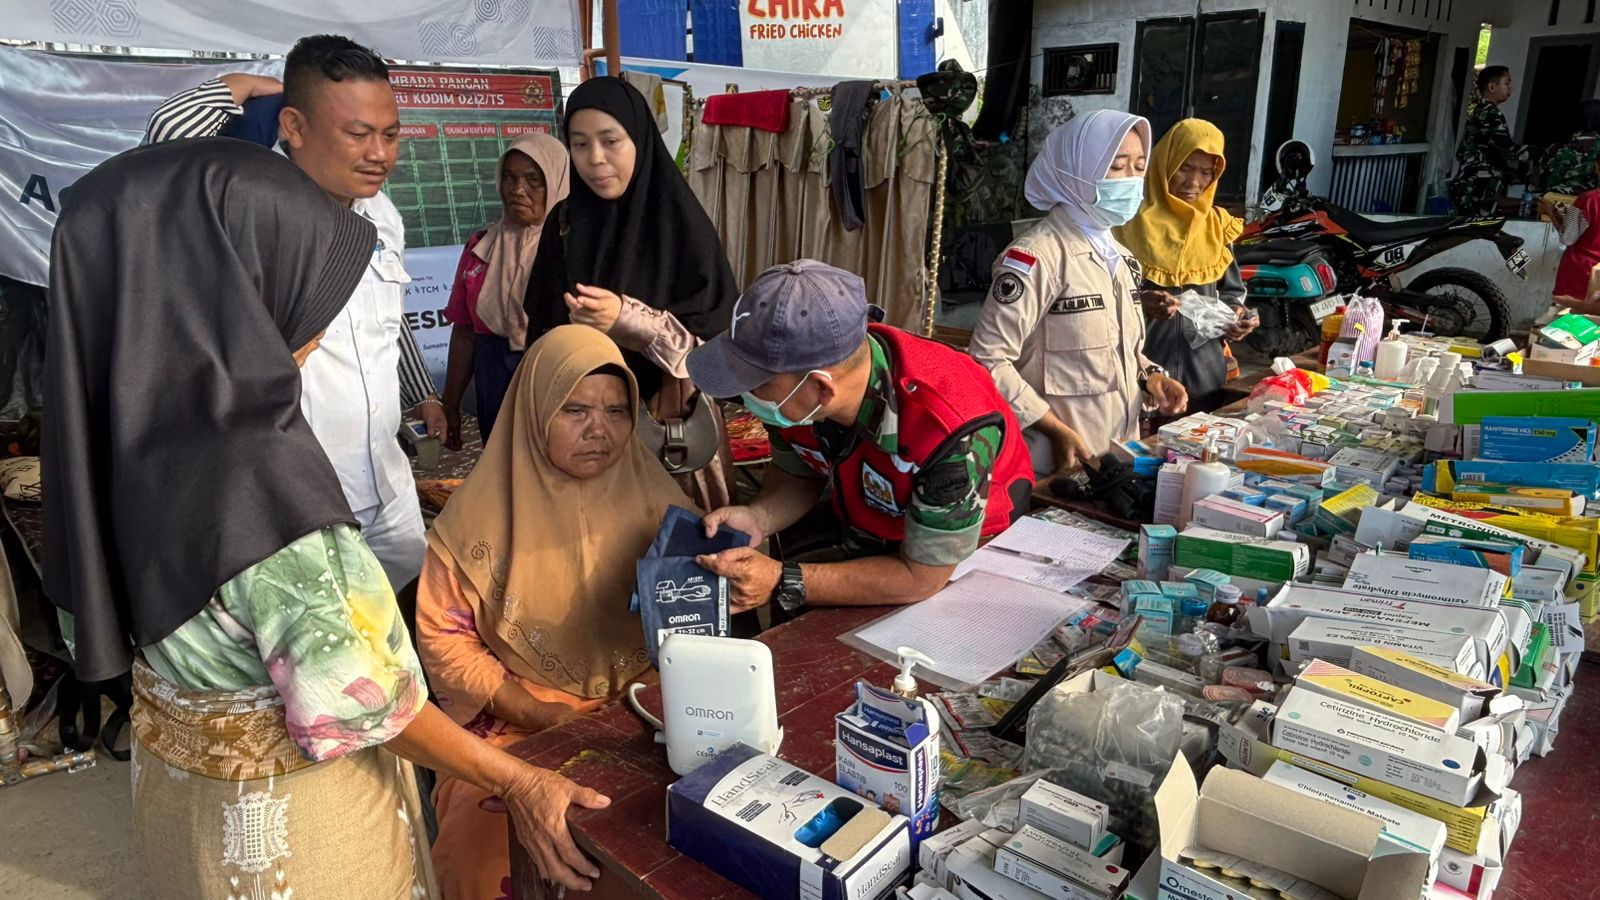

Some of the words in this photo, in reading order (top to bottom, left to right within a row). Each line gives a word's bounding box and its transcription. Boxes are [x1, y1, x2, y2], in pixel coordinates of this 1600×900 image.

[413, 93, 454, 105] KODIM
[19, 173, 56, 213] A
[1353, 583, 1399, 598] Dihydrate
[1400, 589, 1469, 606] Azithromycin
[669, 613, 701, 624] OMRON
[1352, 612, 1430, 628] MEFENAMIC
[1325, 632, 1372, 645] COMPLEX
[1382, 639, 1424, 650] VITAMIN
[1347, 682, 1405, 706] CAPTOPRIL
[685, 706, 734, 721] OMRON
[1320, 701, 1365, 719] Cetirizine
[1368, 716, 1441, 743] Hydrochloride
[841, 730, 904, 766] Hansaplast
[1282, 729, 1309, 744] Cetirizine
[1310, 738, 1352, 756] Hydrochloride
[838, 755, 857, 771] KAIN
[711, 758, 779, 806] HandSeal
[893, 781, 909, 794] 100
[915, 750, 925, 809] Hansaplast
[856, 850, 902, 899] HandSeal
